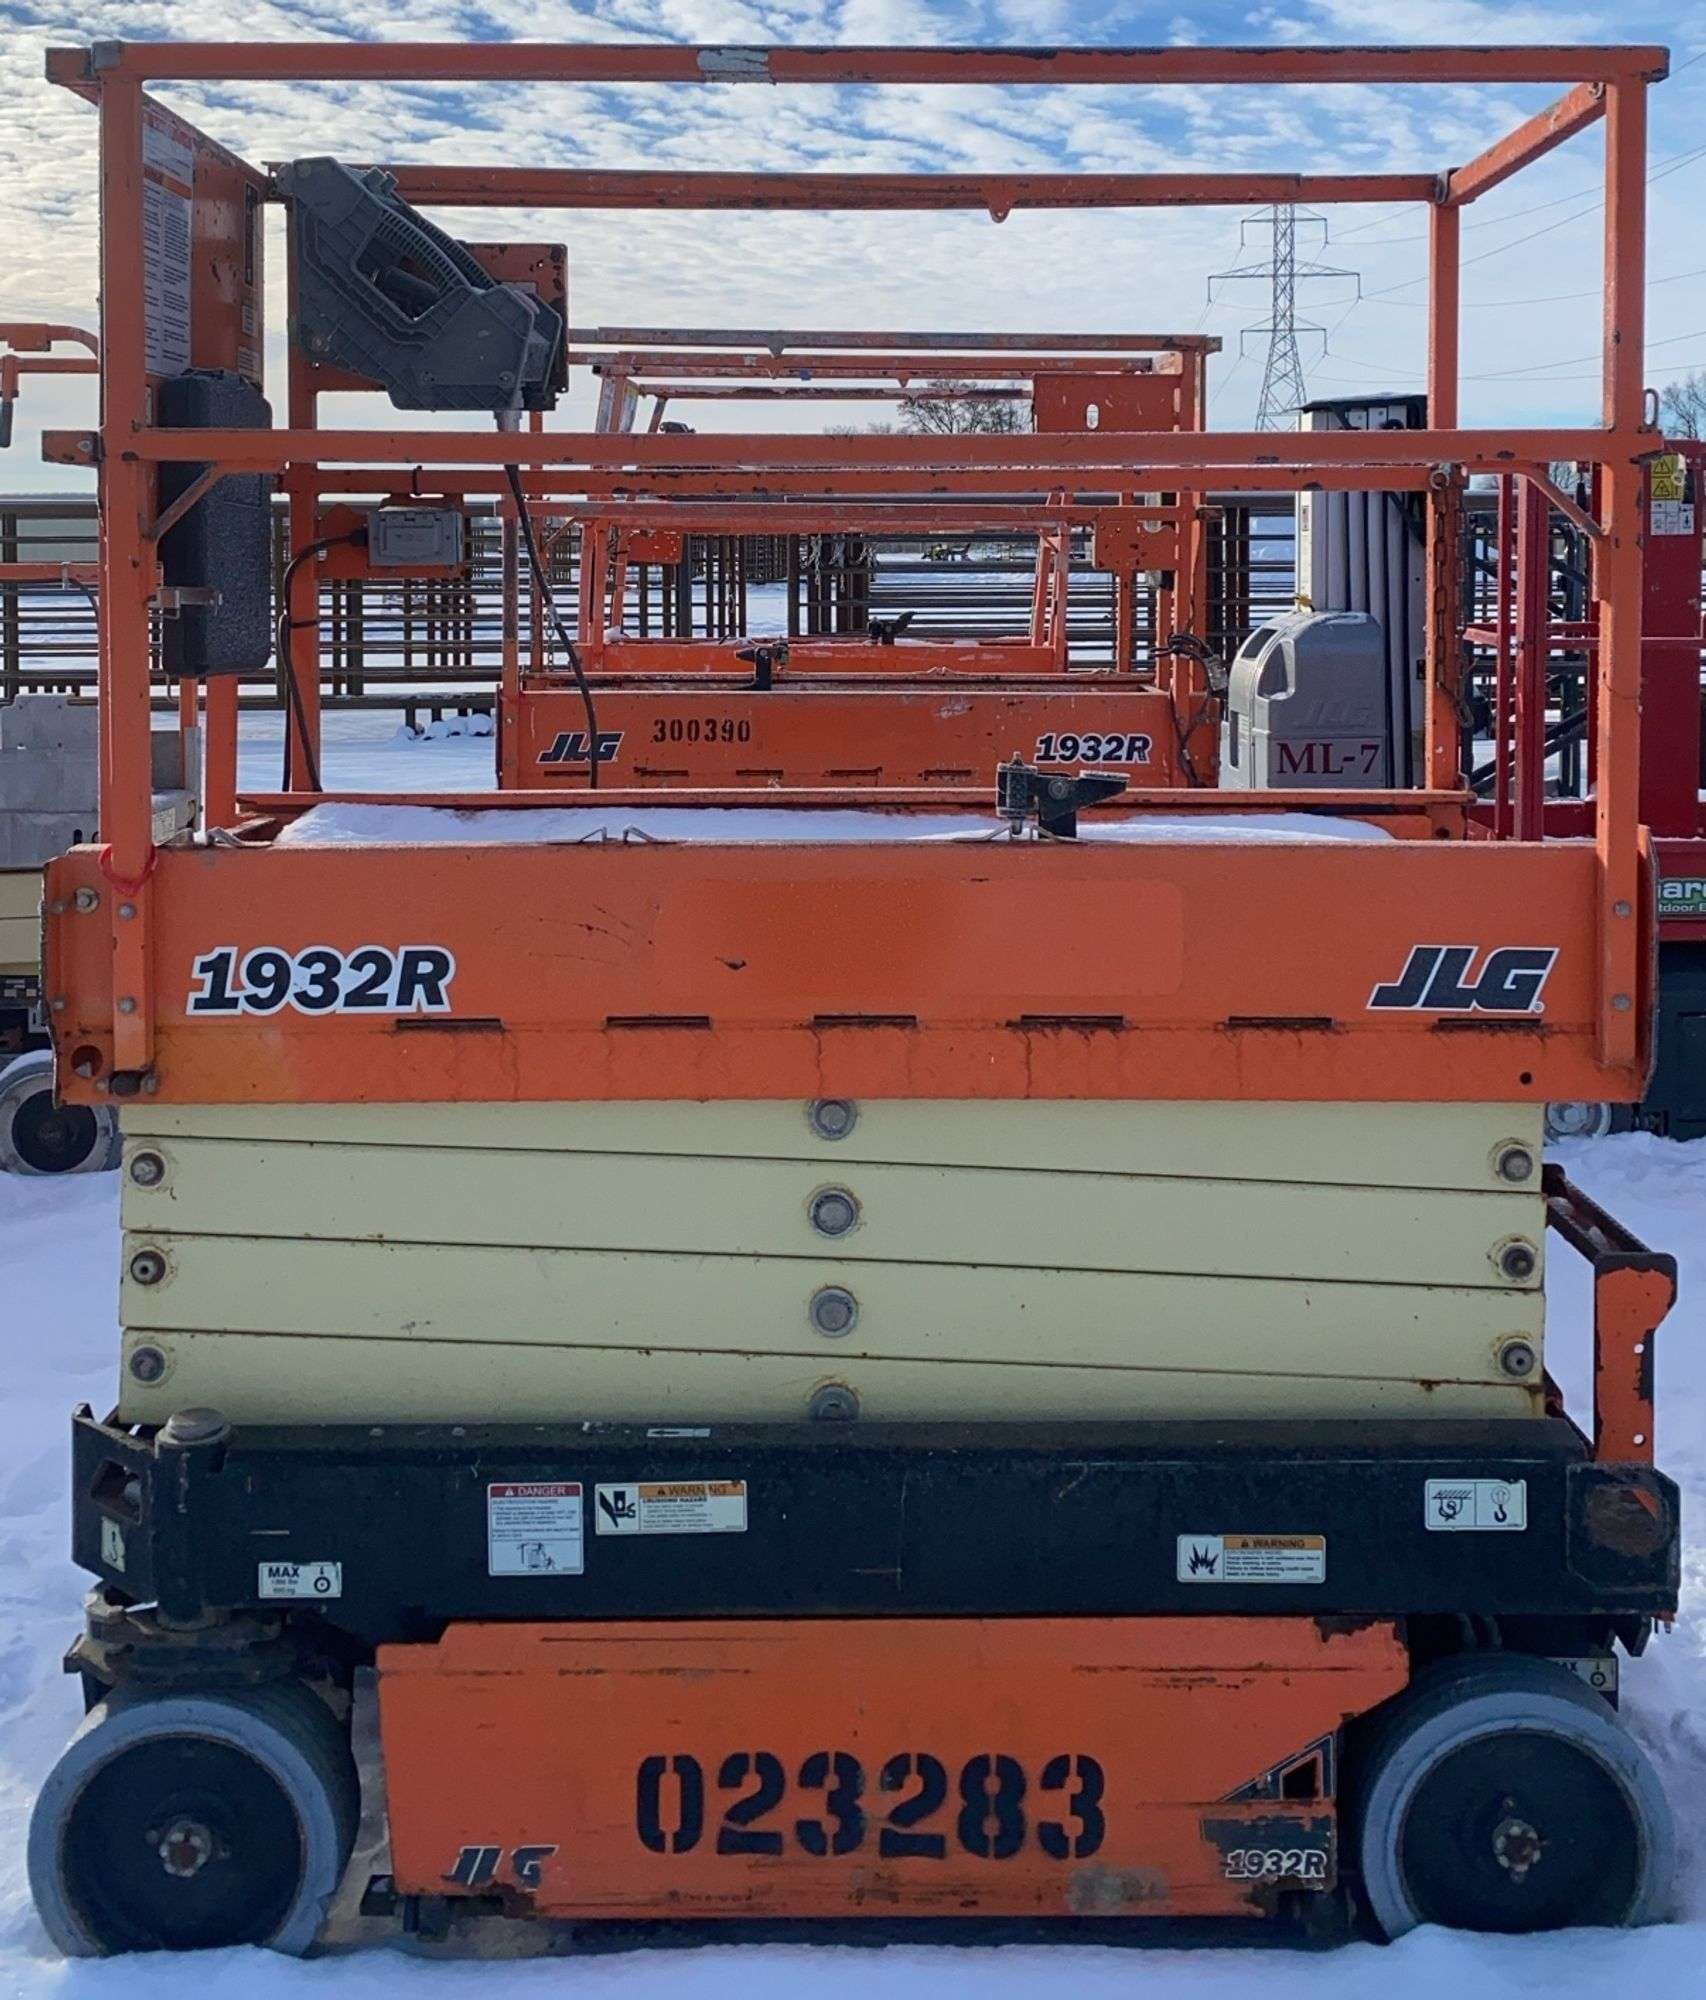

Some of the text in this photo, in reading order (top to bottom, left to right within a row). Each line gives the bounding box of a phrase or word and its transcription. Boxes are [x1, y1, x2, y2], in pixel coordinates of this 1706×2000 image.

[652, 718, 751, 743] 300390
[536, 732, 625, 763] JLG
[1033, 732, 1152, 764] 1932R
[1276, 742, 1380, 775] ML-7
[1658, 881, 1706, 899] ar
[186, 944, 456, 1016] 1932R
[1366, 944, 1560, 1013] JLG
[517, 1486, 566, 1496] DANGER
[669, 1484, 728, 1497] WARNNG
[1253, 1538, 1305, 1548] WARNING
[268, 1566, 300, 1578] MAX
[635, 1750, 1106, 1860] 023283
[1225, 1849, 1327, 1879] 1932R
